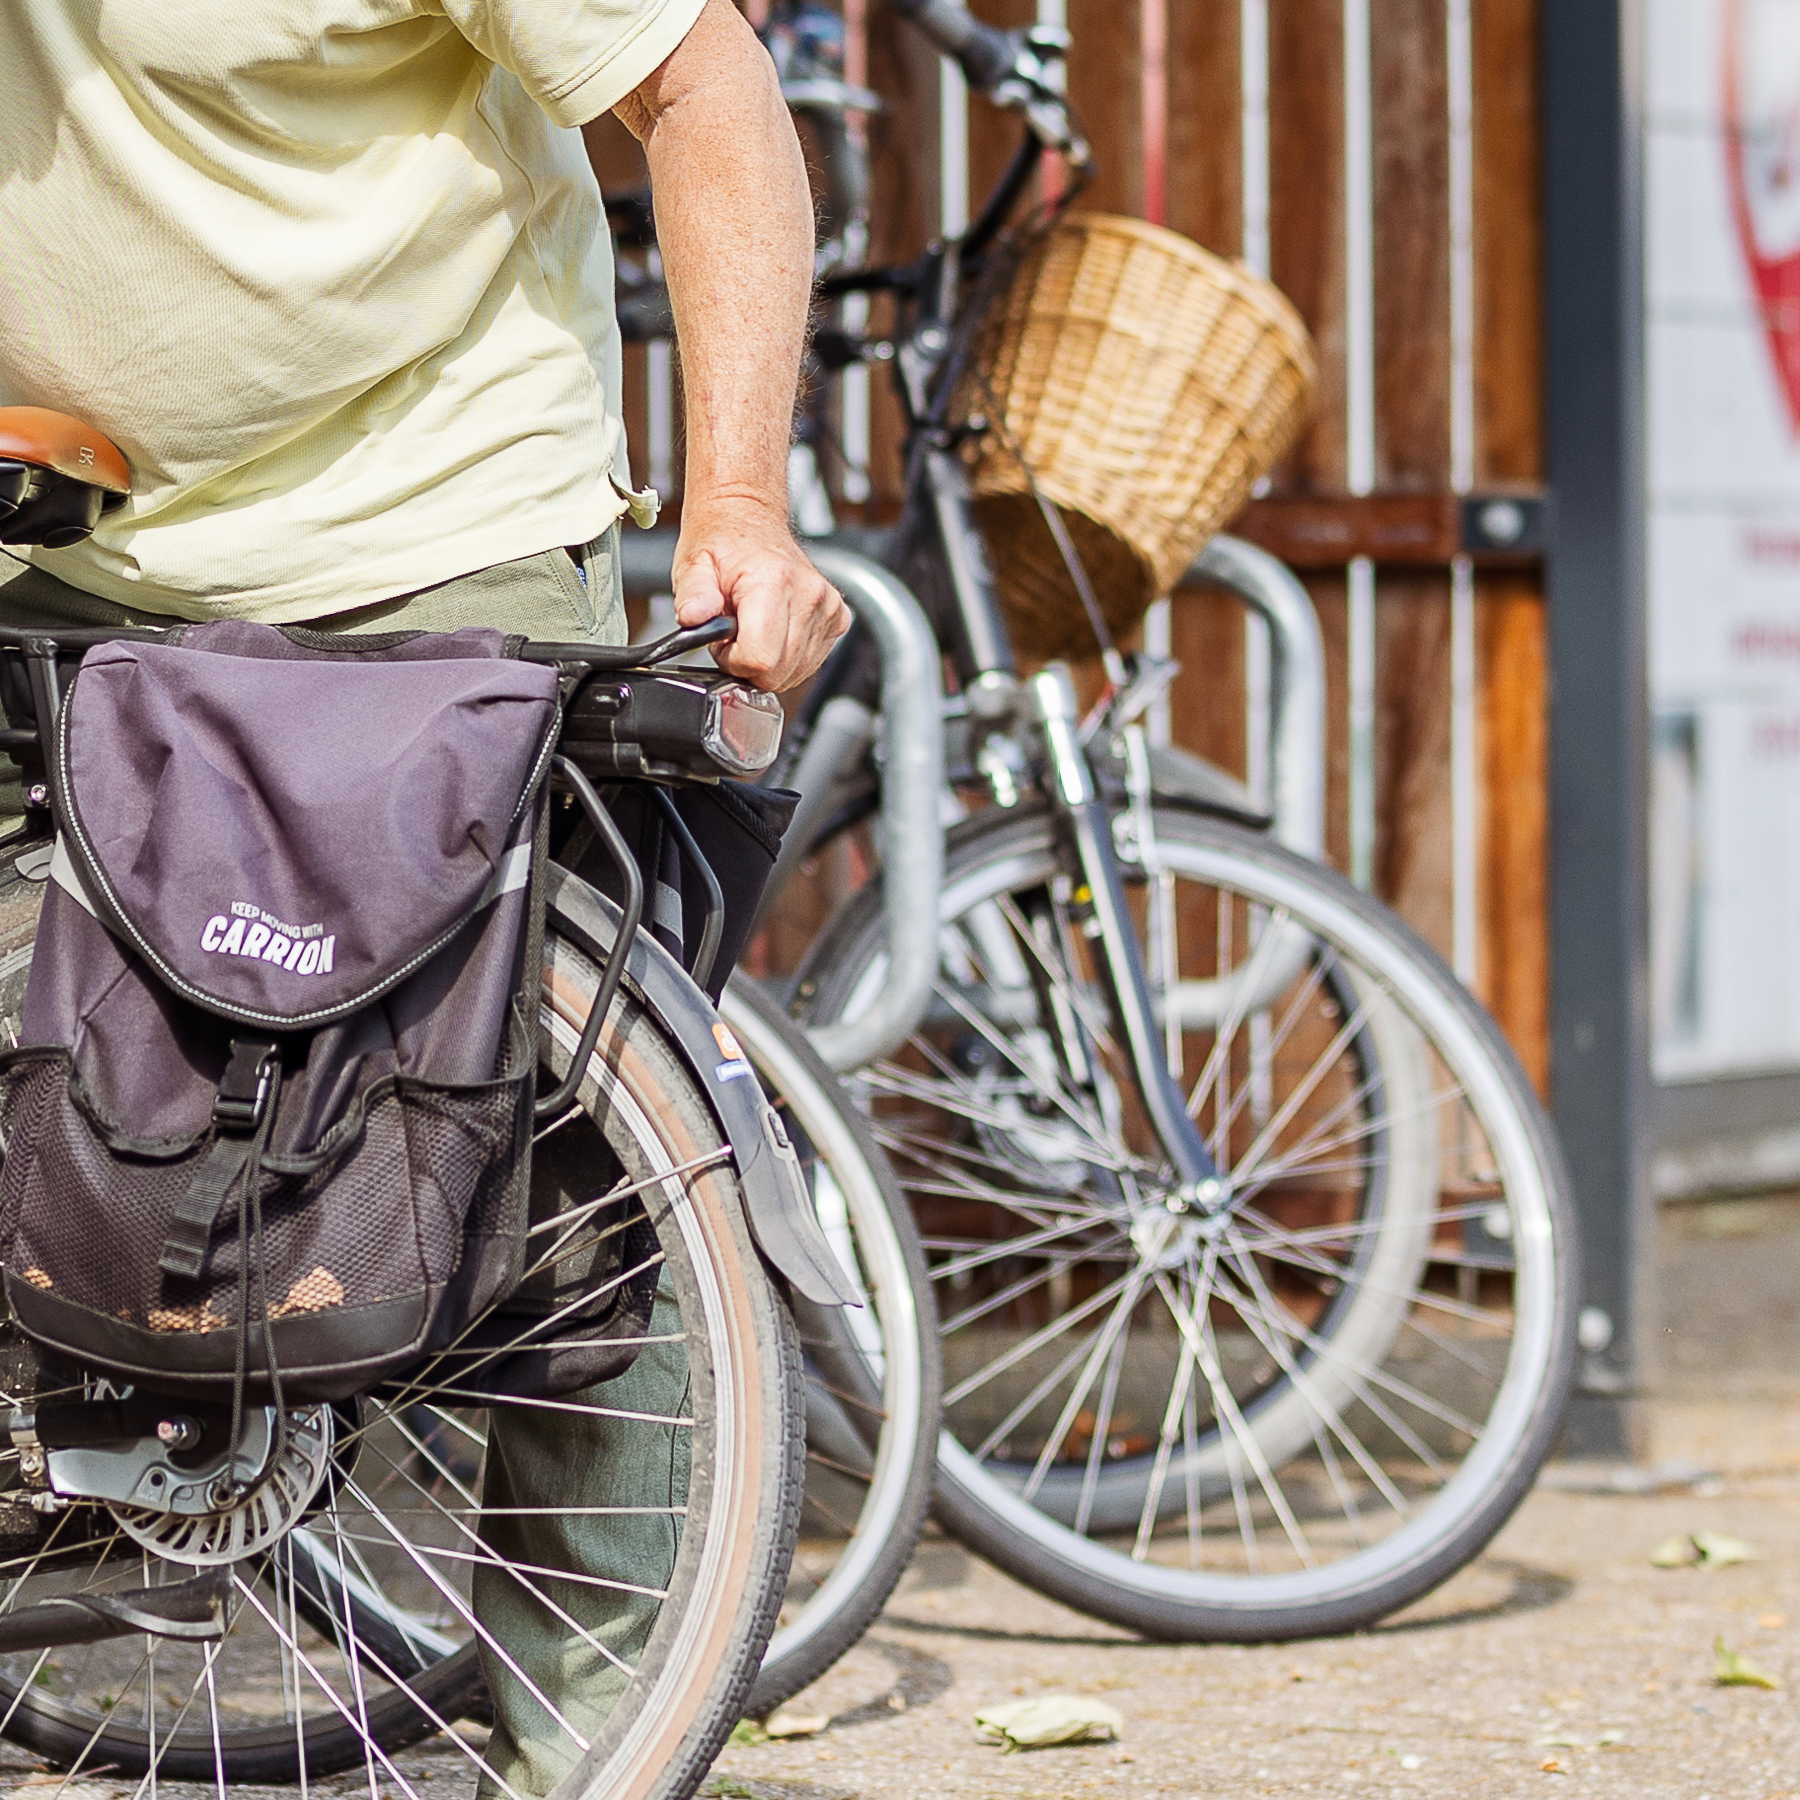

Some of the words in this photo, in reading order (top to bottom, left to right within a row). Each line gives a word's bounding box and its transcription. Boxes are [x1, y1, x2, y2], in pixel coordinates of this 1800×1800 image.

[231, 901, 260, 919] KEEP
[261, 911, 300, 939] MOVING
[301, 923, 324, 939] WITH
[201, 915, 336, 975] CARRION
